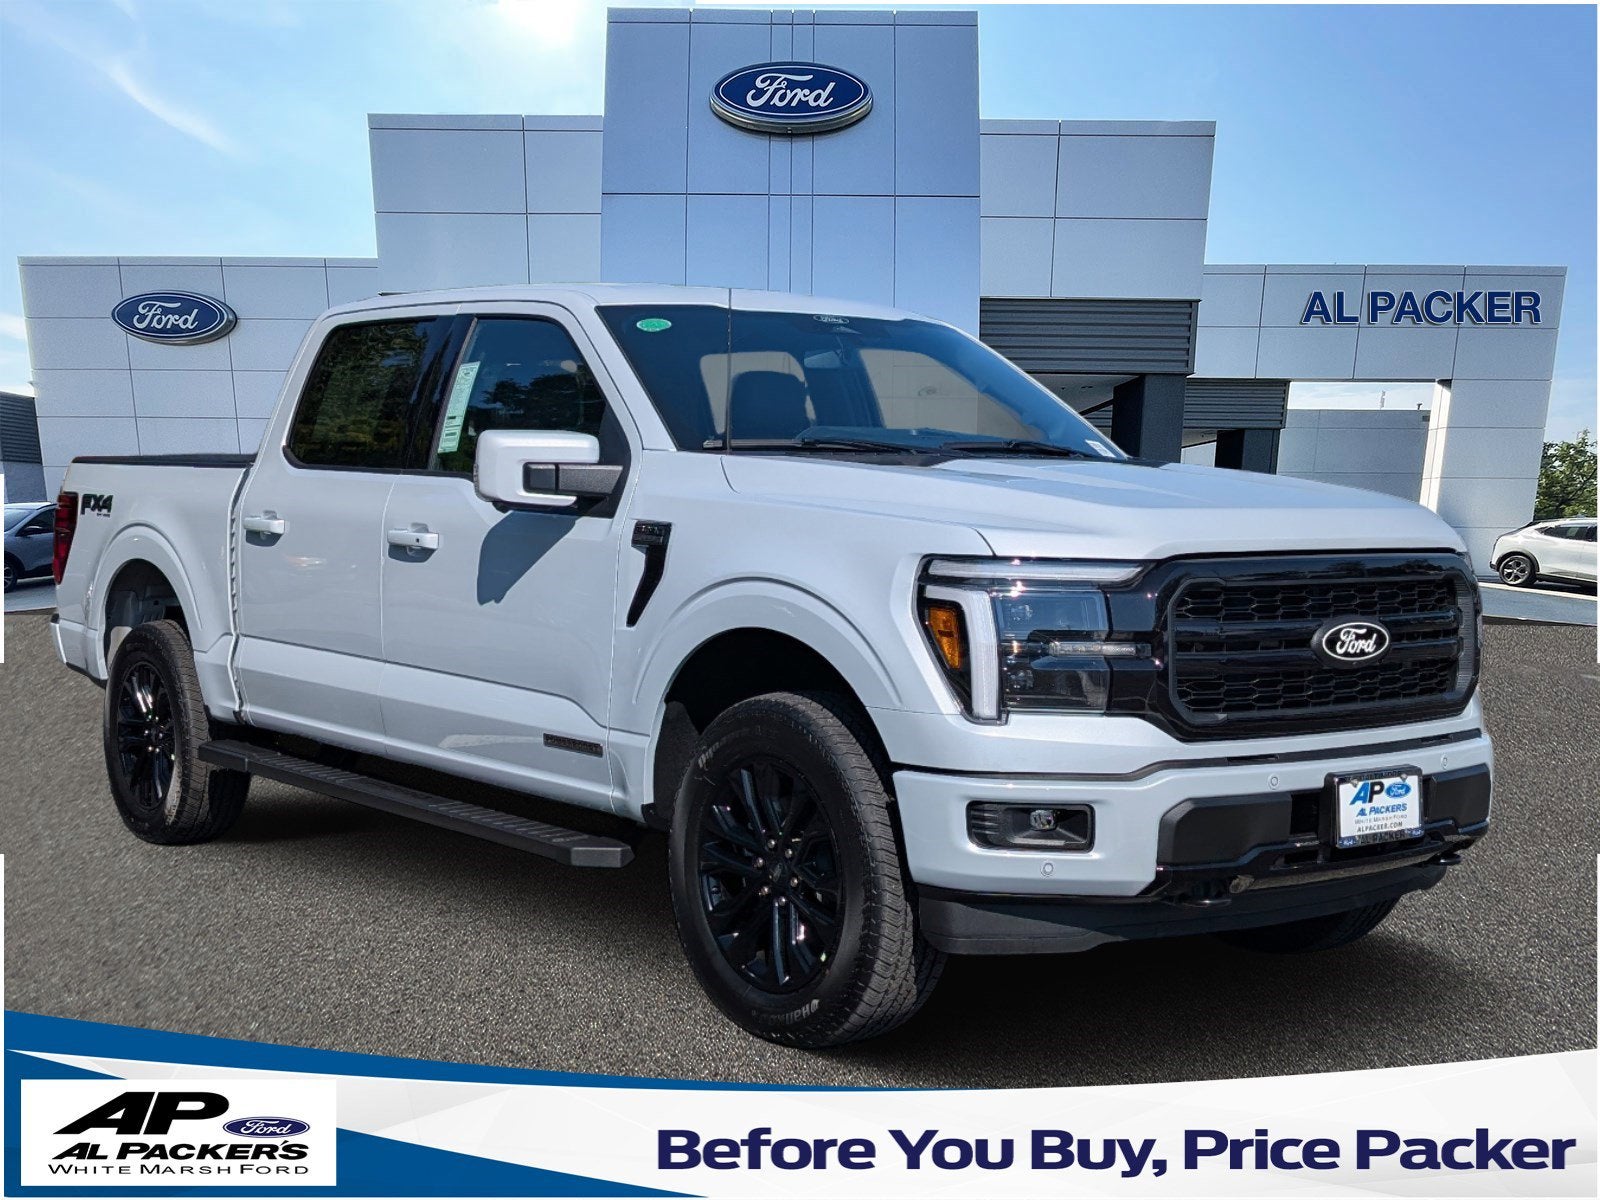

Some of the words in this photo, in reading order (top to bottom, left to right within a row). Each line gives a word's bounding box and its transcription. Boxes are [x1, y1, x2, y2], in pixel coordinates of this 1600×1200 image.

[746, 73, 836, 107] Ford
[133, 301, 199, 329] Ford
[1301, 290, 1359, 324] AL
[1367, 290, 1542, 324] PACKER
[80, 494, 114, 516] FX4
[1336, 628, 1377, 655] Ford
[1349, 780, 1385, 806] AP
[1355, 807, 1368, 818] AL
[1369, 803, 1408, 816] PACKERS
